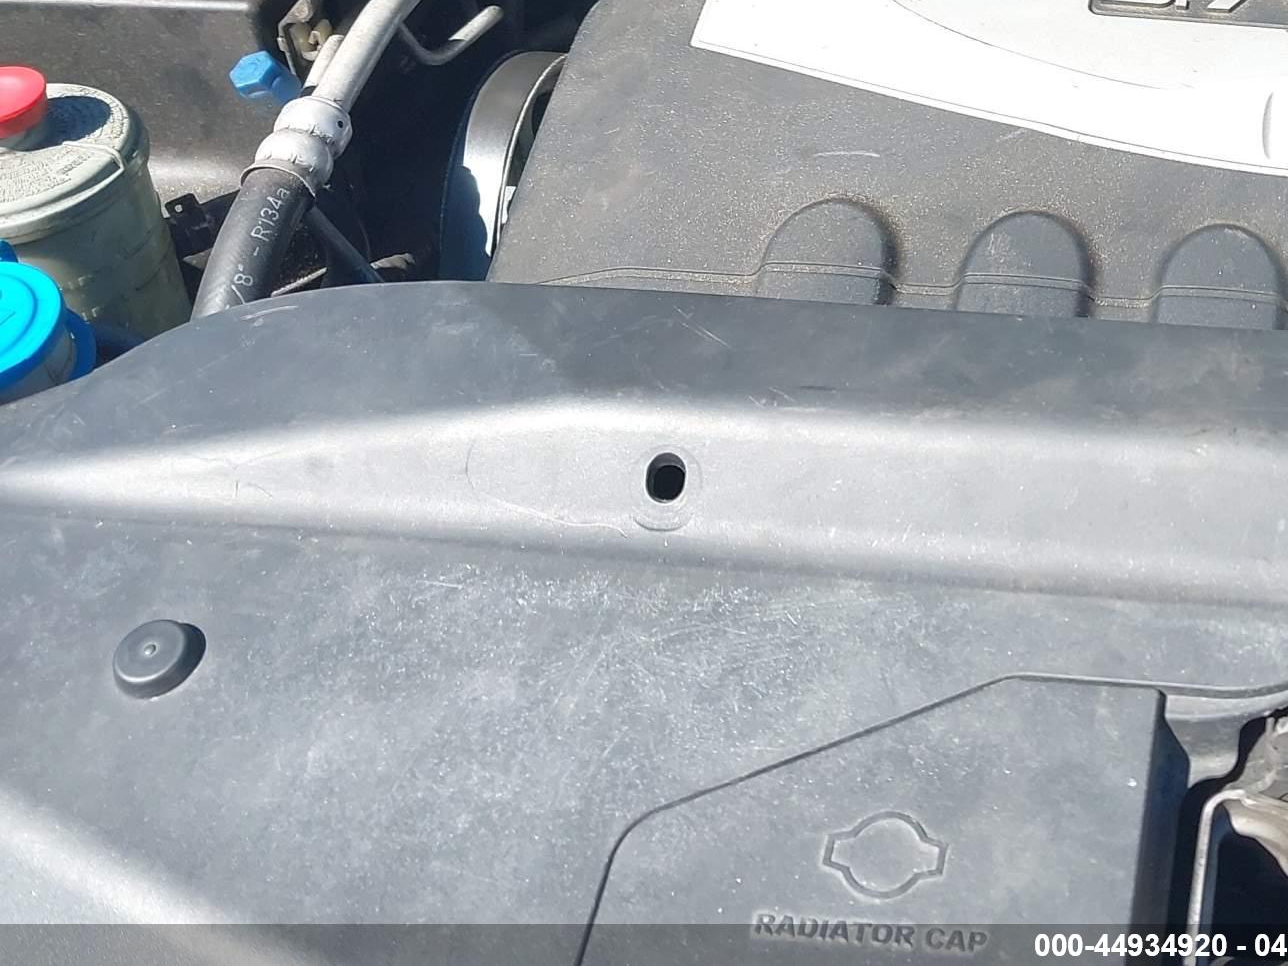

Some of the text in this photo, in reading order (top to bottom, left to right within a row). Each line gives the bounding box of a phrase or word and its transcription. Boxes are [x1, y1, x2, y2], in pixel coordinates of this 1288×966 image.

[250, 187, 290, 242] R134a
[754, 913, 988, 952] RADIATOR CAP
